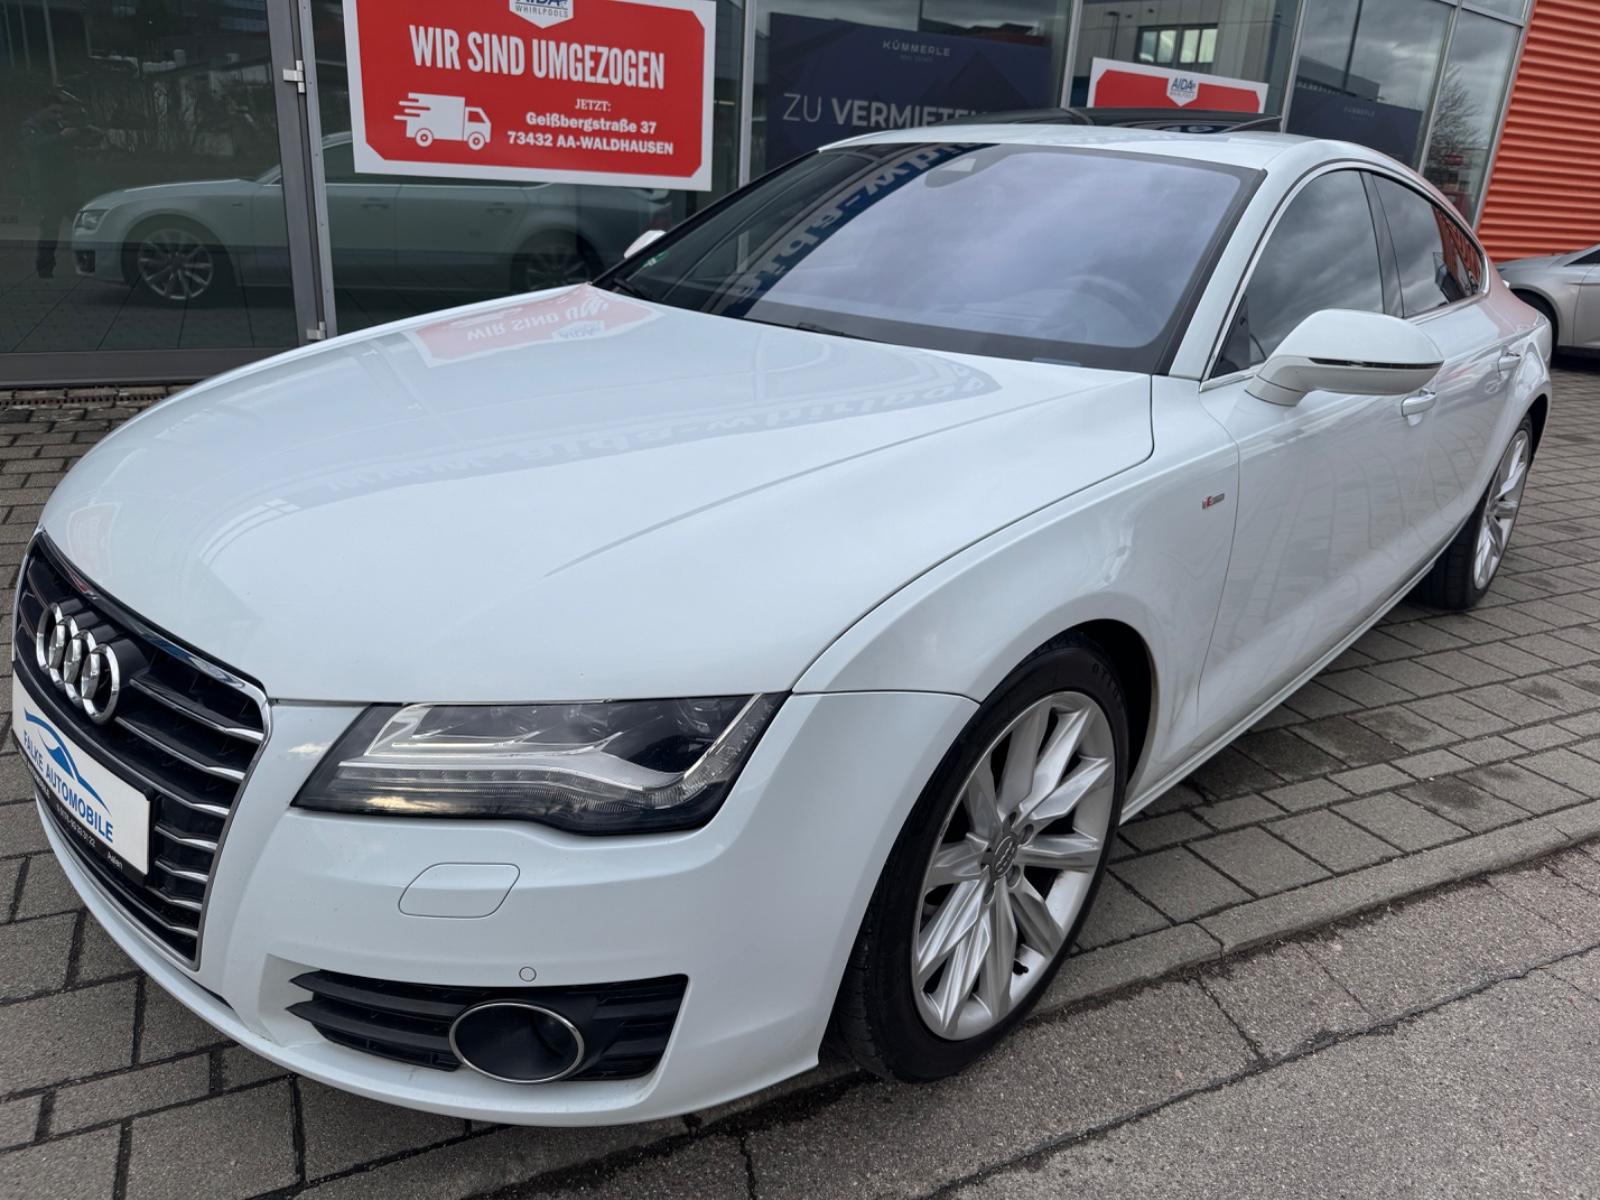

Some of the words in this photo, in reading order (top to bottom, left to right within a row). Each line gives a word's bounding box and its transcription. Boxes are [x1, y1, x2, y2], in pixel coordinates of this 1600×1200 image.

[408, 24, 461, 70] WIR
[467, 32, 524, 76] SIND
[532, 39, 666, 90] UMGEZOGEN
[883, 40, 950, 56] KÜMMERLE
[575, 98, 612, 112] JETZT:
[782, 92, 822, 123] ZU
[831, 97, 985, 129] VERMIET
[526, 111, 638, 132] Geißbergstraße
[640, 121, 657, 134] 37
[507, 130, 554, 147] 73432
[557, 134, 675, 155] AA-WALDHAUSEN
[24, 730, 44, 773] FALKE
[46, 763, 113, 843] AUTOMOBILE
